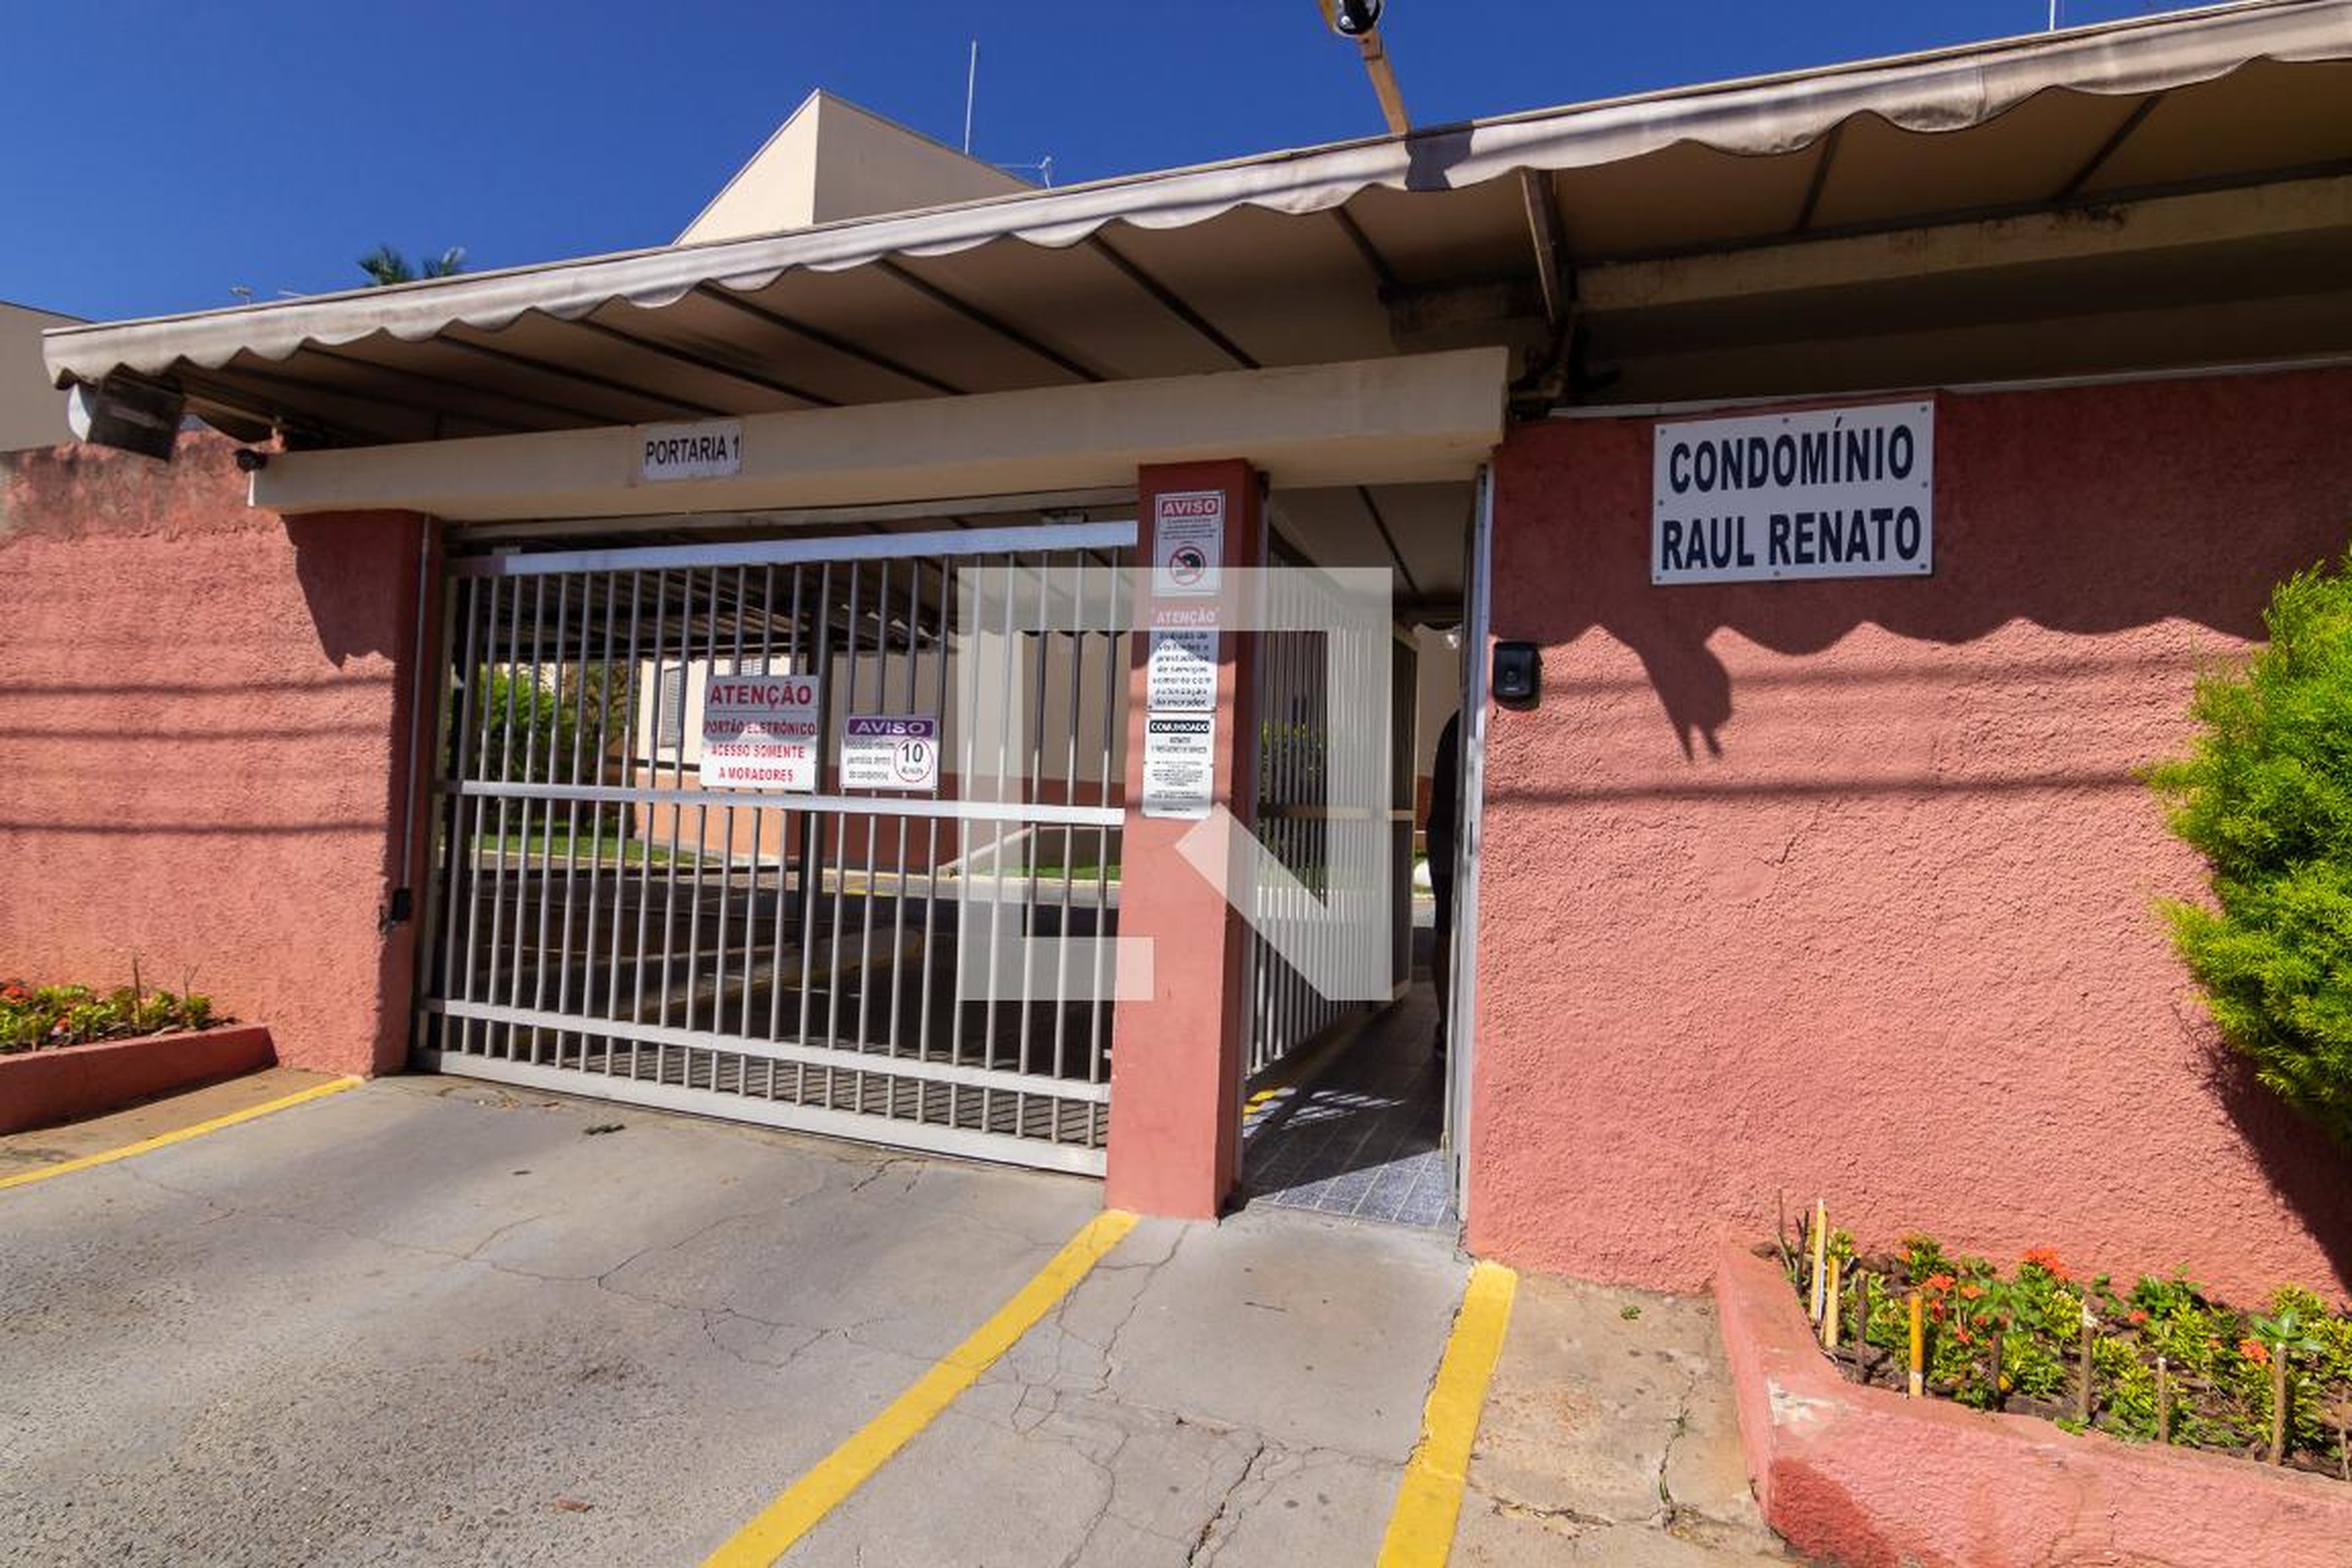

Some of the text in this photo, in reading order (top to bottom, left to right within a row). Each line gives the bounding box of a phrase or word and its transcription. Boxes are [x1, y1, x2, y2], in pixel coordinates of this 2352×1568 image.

[645, 434, 739, 466] PORTARIA 1
[1670, 417, 1914, 494] CONDOMÍNIO
[1164, 500, 1216, 515] AVISO
[1662, 506, 1921, 570] RAUL RENATO
[1156, 608, 1216, 624] ATENÇÃO
[710, 681, 812, 708] ATENÇÃO
[704, 718, 744, 733] PORTÃO
[856, 721, 925, 734] AVISO
[1151, 722, 1209, 731] COMUNICADO
[712, 744, 805, 758] ACESSO SOMENTE
[902, 742, 924, 763] 10
[728, 767, 793, 782] MORADORES
